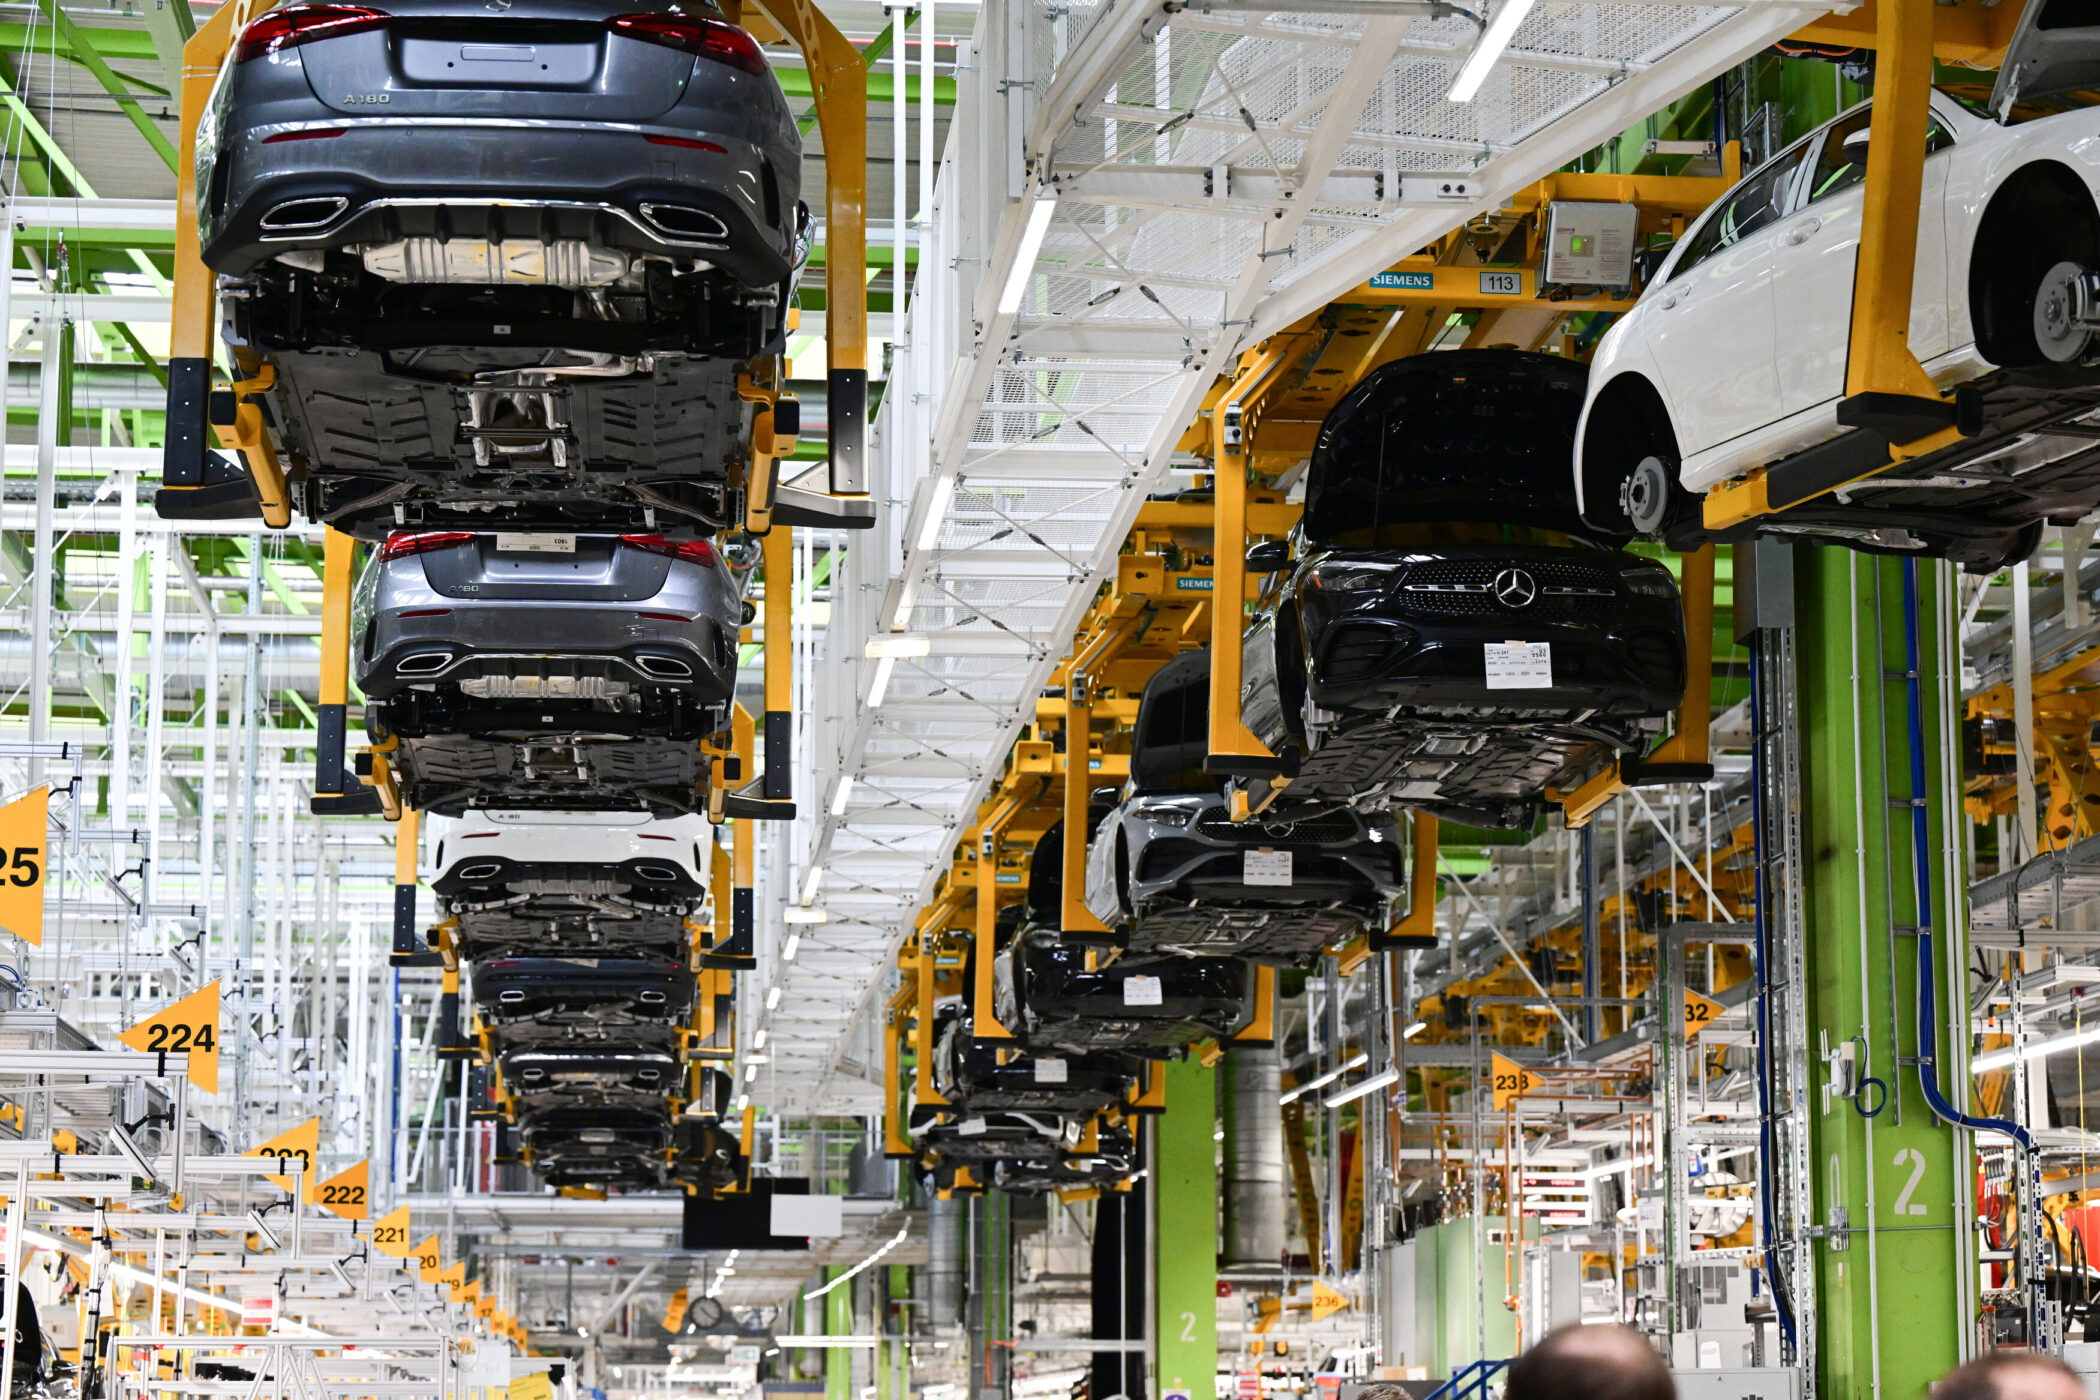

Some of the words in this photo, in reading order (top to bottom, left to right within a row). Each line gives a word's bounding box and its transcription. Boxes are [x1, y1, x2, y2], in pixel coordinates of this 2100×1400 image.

[1373, 274, 1430, 286] SIEMENS
[1488, 276, 1513, 290] 113
[147, 1024, 215, 1052] 224
[1893, 1148, 1927, 1215] 2
[322, 1186, 365, 1204] 222
[374, 1228, 404, 1243] 221
[1315, 1295, 1339, 1307] 236
[1180, 1311, 1196, 1342] 2
